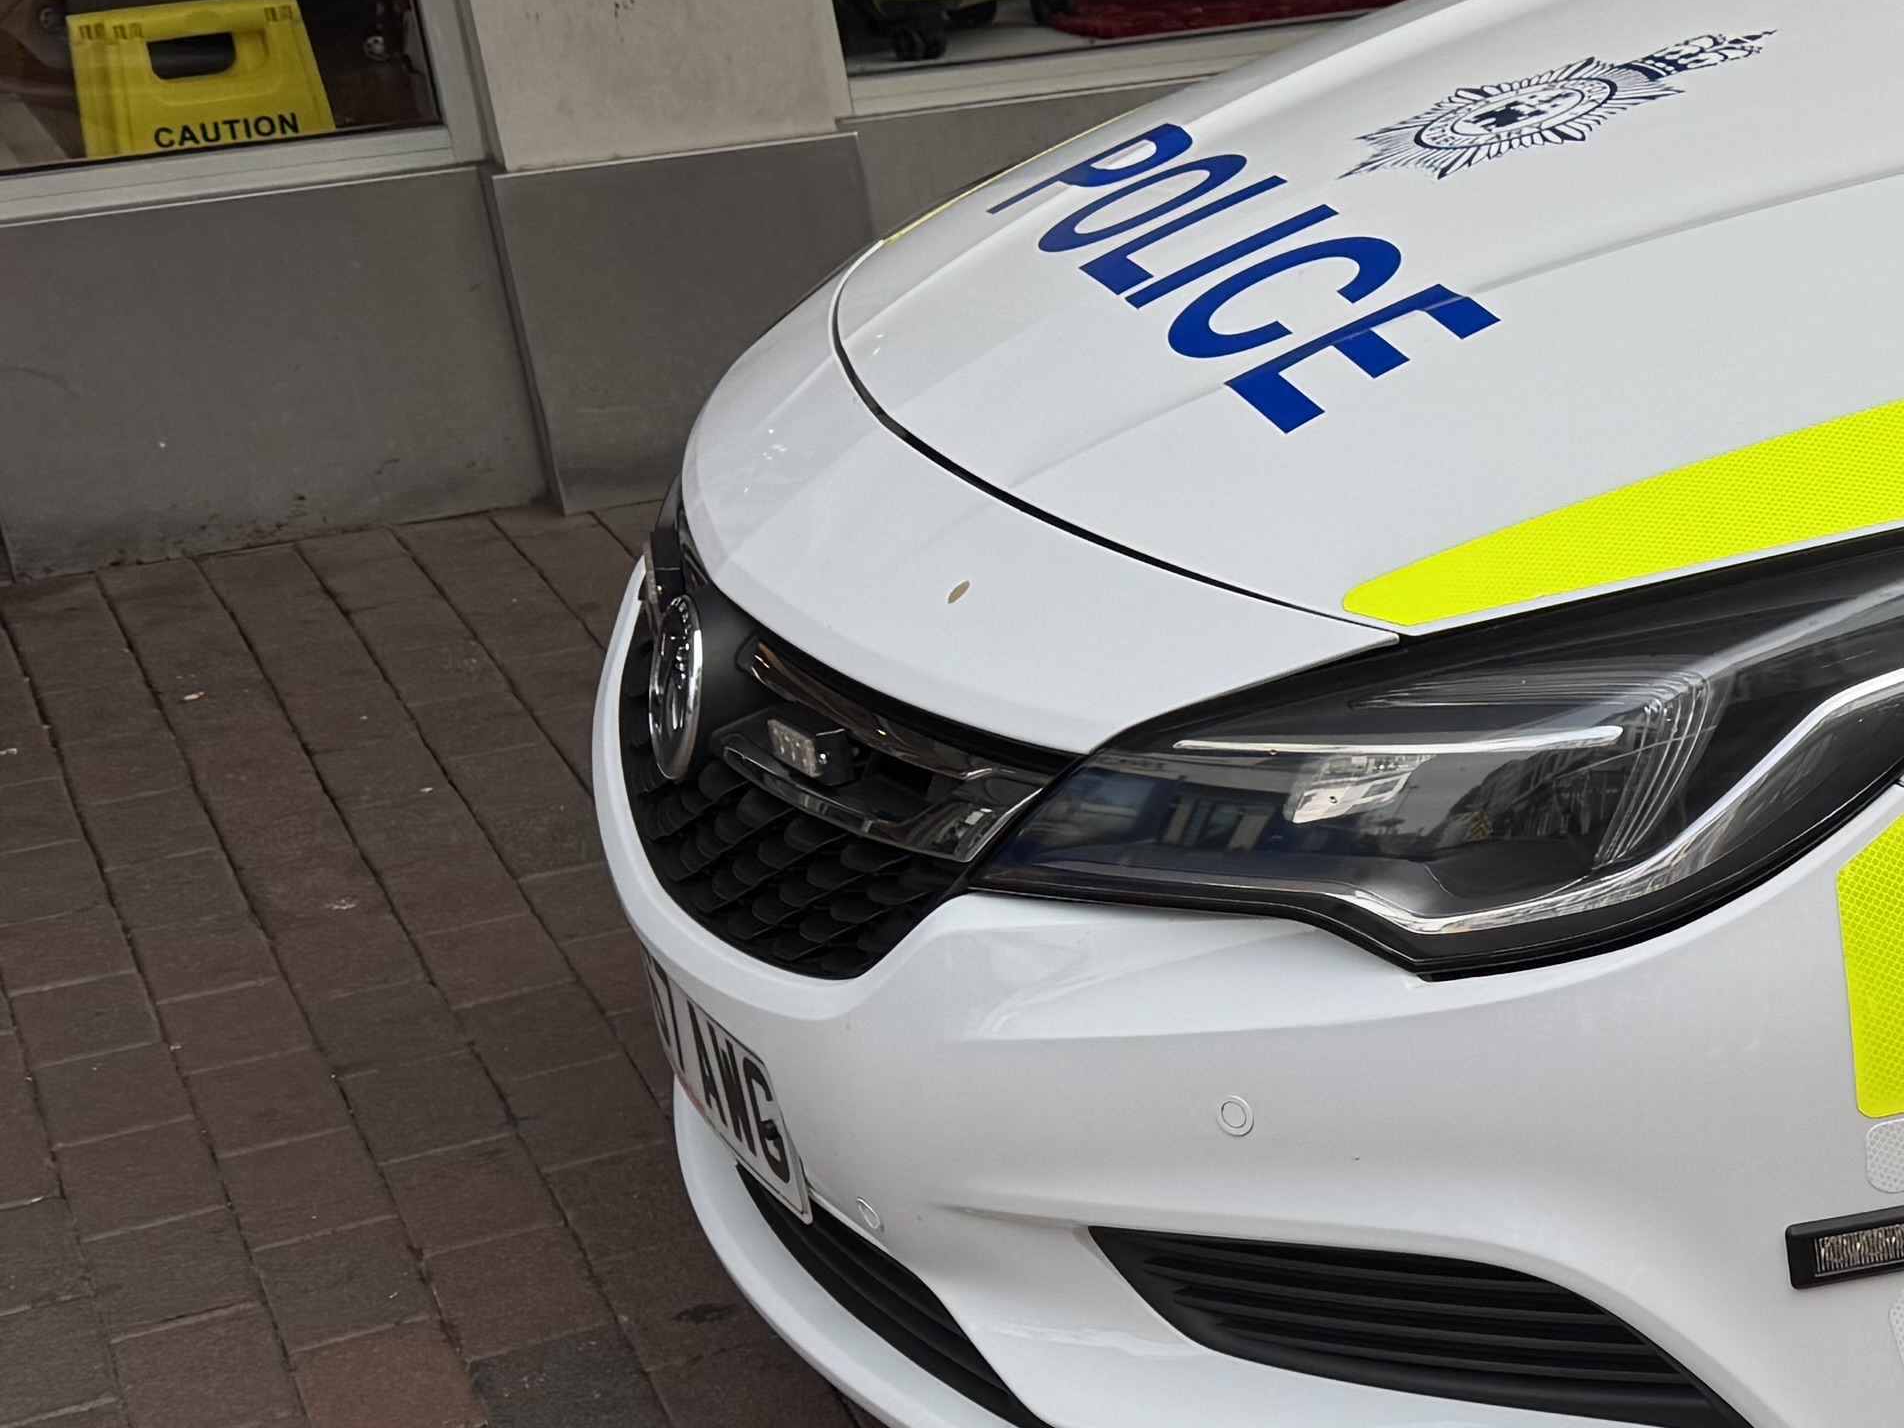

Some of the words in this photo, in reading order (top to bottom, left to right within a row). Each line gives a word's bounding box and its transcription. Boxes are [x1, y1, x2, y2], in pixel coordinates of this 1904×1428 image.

[153, 111, 301, 149] CAUTION
[987, 122, 1501, 435] POLICE
[687, 999, 790, 1184] AWG
